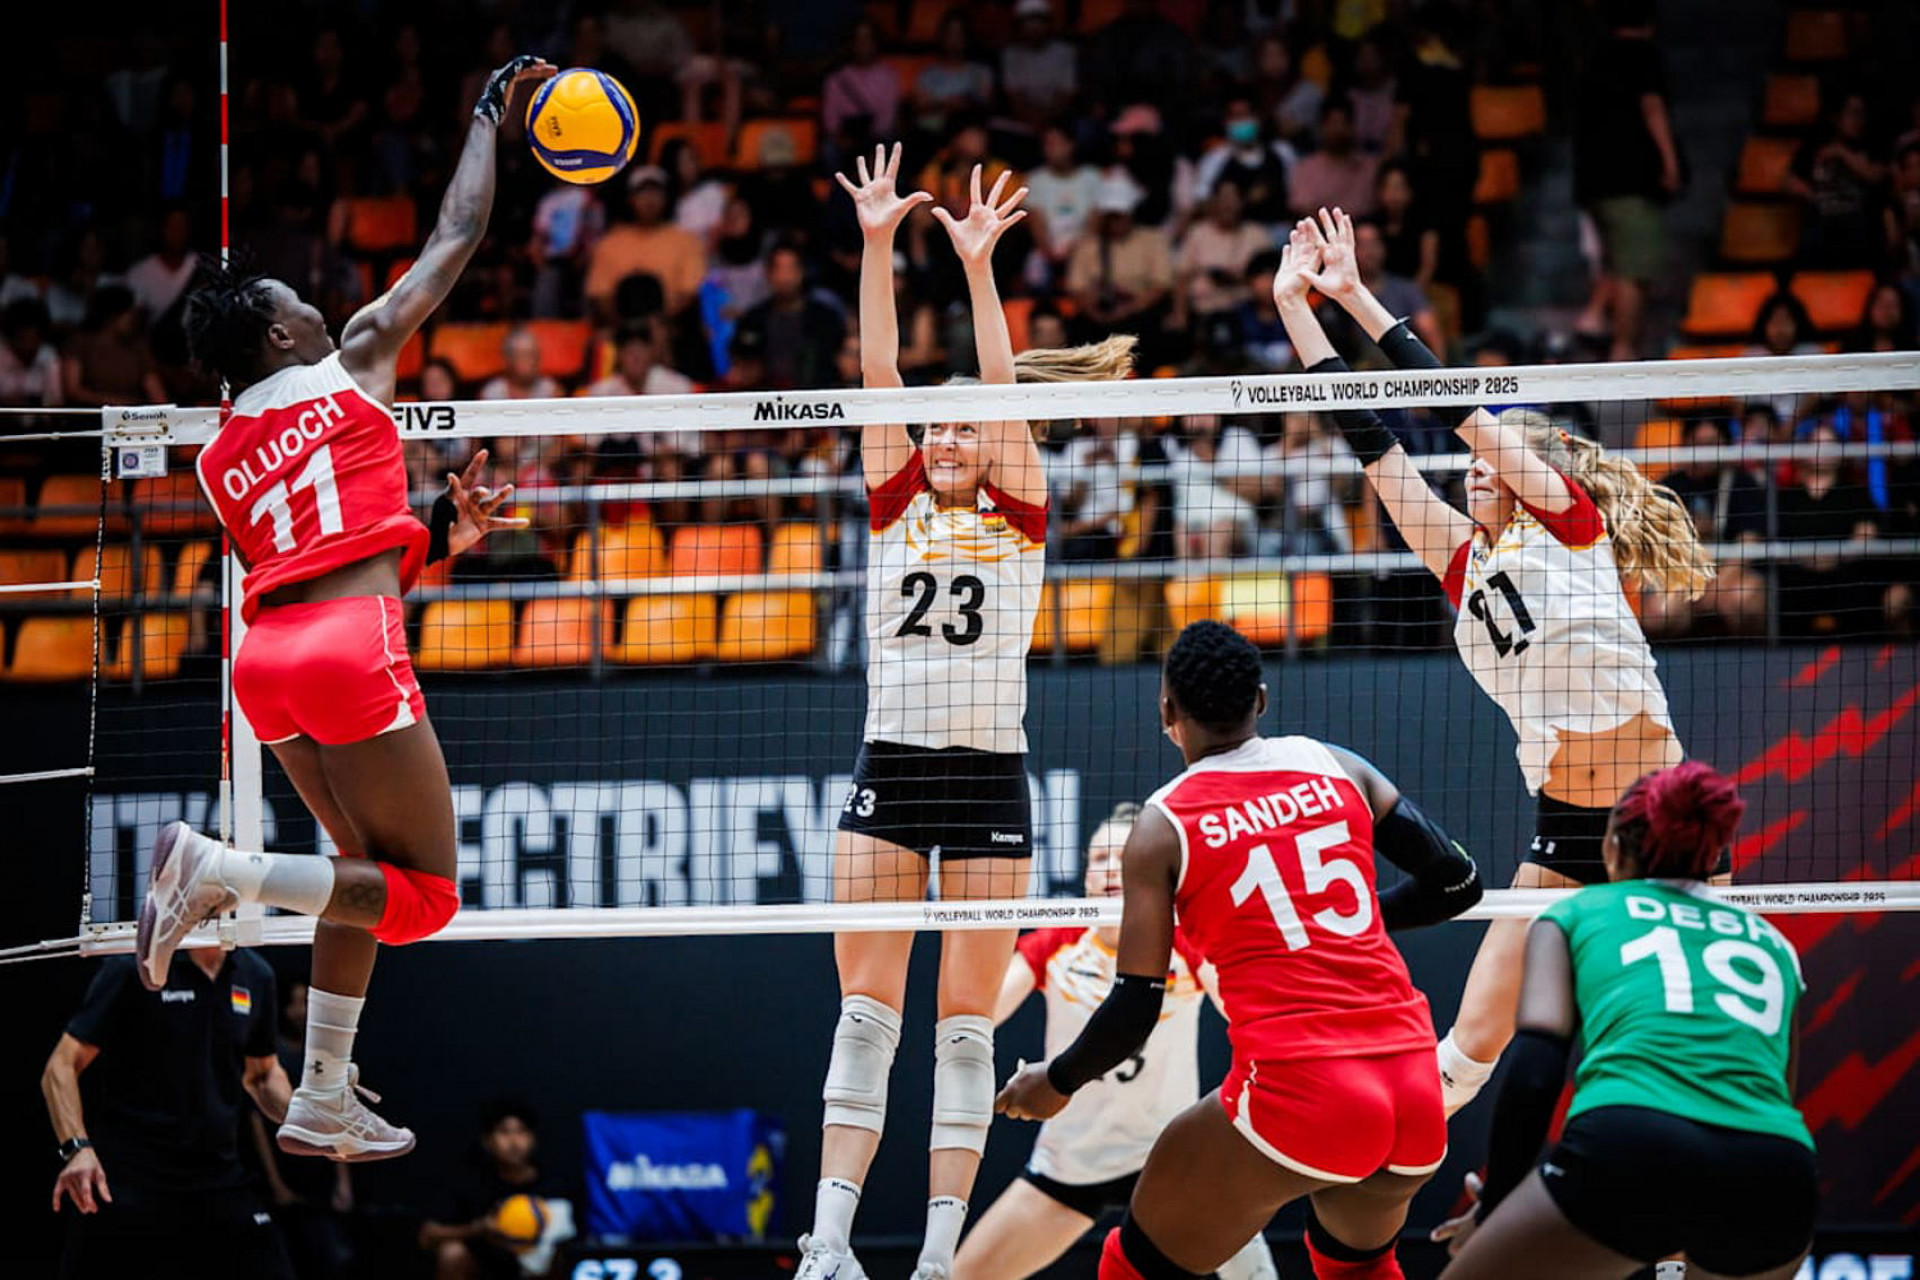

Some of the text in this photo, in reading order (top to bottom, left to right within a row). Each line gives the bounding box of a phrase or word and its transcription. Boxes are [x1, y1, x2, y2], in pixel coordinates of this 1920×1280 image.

[1248, 376, 1519, 404] VOLLEYBALL WORLD CHAMPIONSHIP 2025
[222, 394, 346, 501] OLUOCH
[251, 443, 344, 554] 11
[895, 571, 985, 646] 23
[1467, 570, 1537, 660] 21
[1199, 776, 1345, 848] SANDEH
[933, 909, 982, 922] VOLLEYBALL
[985, 908, 1014, 920] WORLD
[1017, 907, 1075, 919] CHAMPIONSHIP
[1229, 819, 1373, 951] 15
[1765, 893, 1795, 905] WORLD
[1798, 891, 1860, 903] CHAMPIONSHIP
[1620, 925, 1785, 1036] 19
